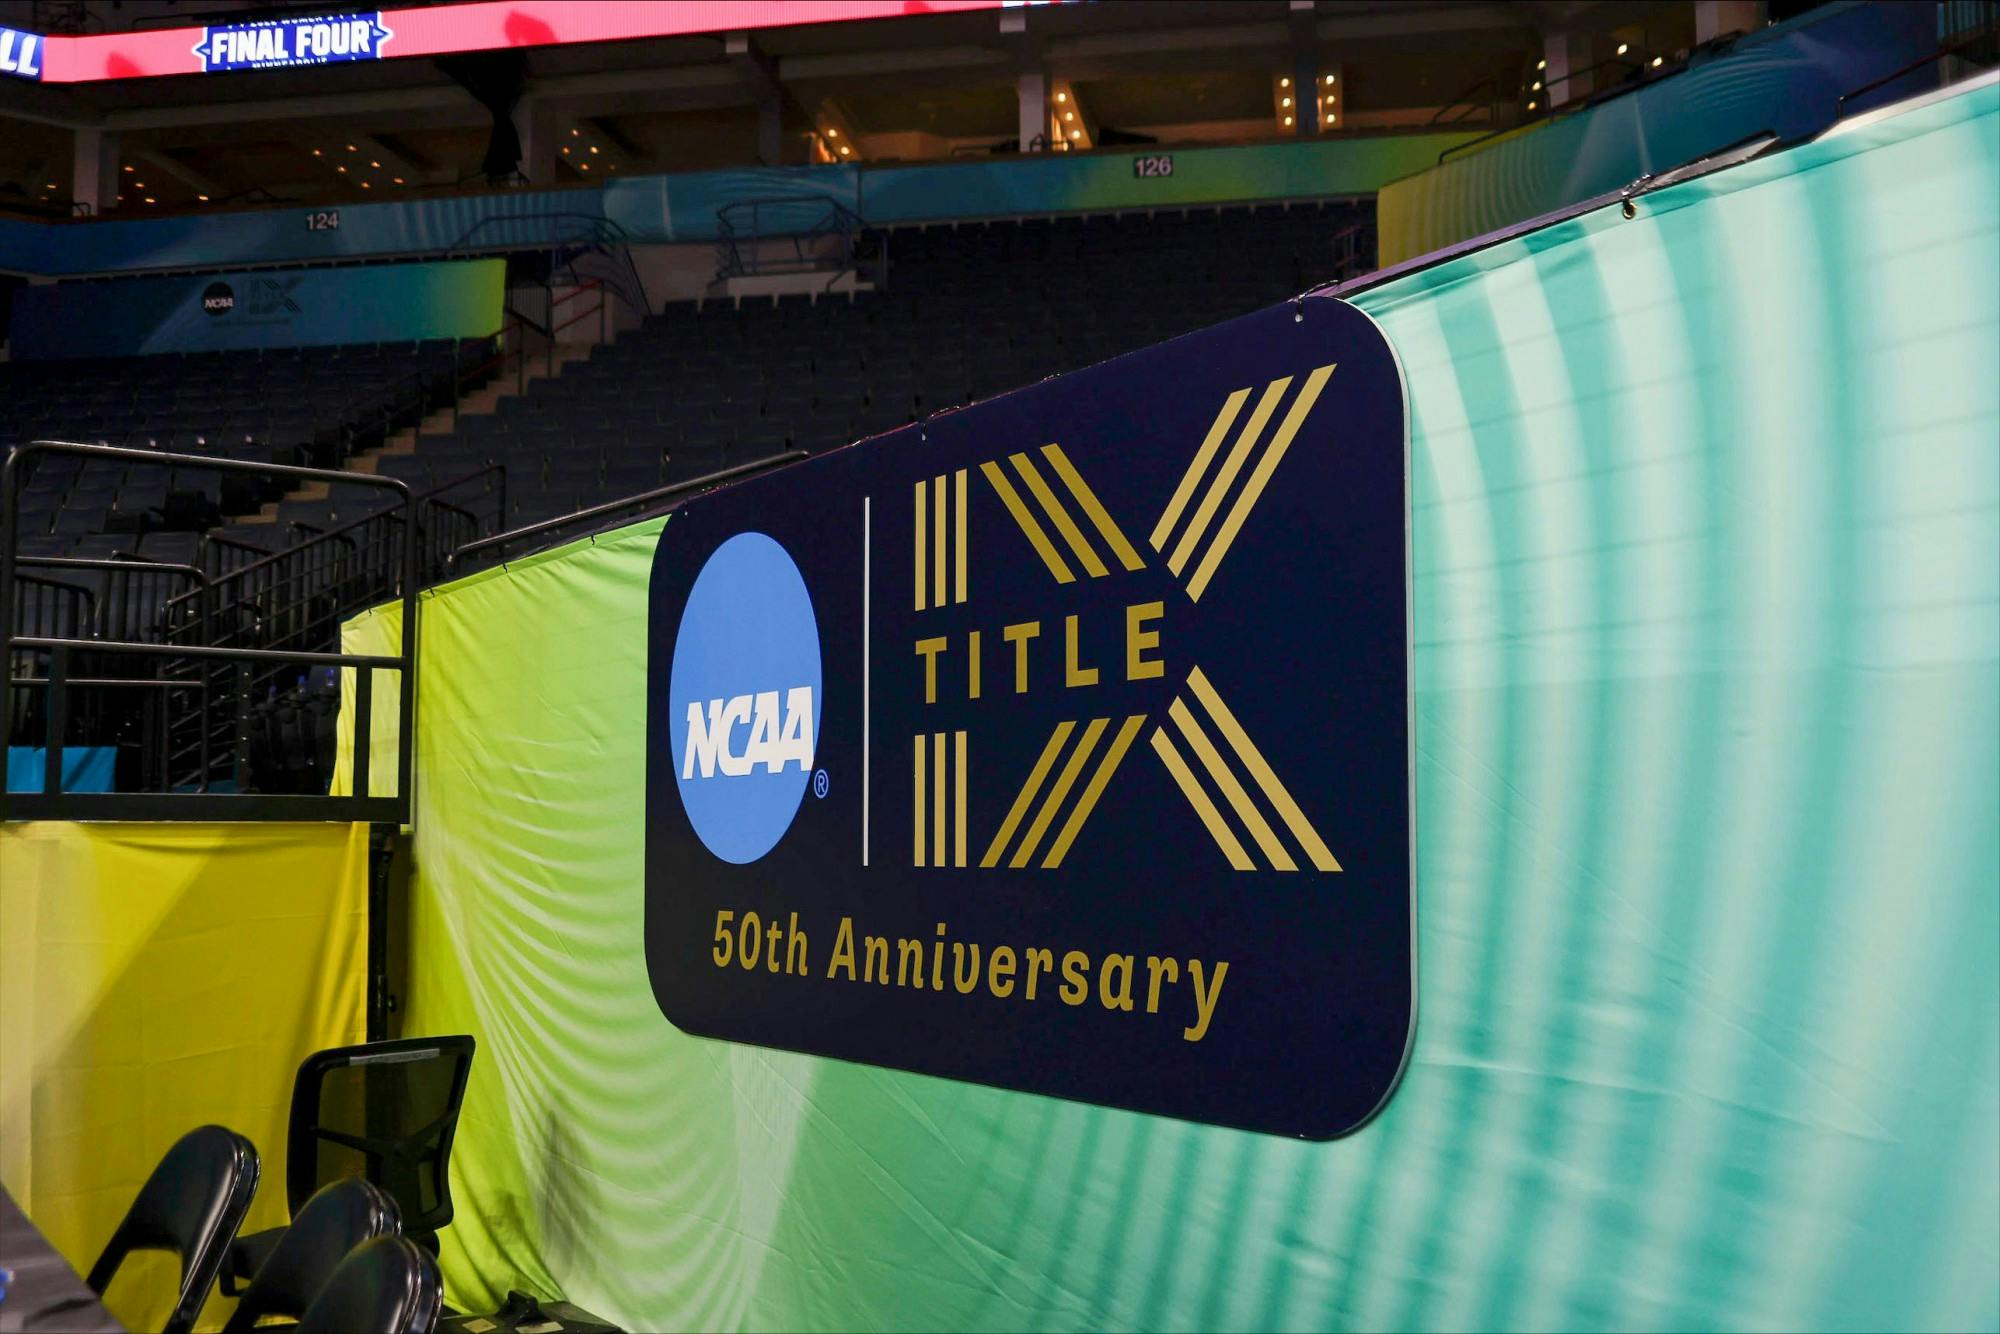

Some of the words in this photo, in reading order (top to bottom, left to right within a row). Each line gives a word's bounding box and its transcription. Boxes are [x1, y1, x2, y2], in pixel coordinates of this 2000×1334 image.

[212, 28, 289, 65] FINAL
[296, 20, 371, 58] FOUR
[1135, 156, 1172, 177] 126
[306, 212, 339, 230] 124
[204, 297, 235, 309] NCAA
[915, 601, 1165, 704] TITLE
[682, 686, 815, 780] NCAA
[712, 910, 809, 977] 50th
[826, 917, 1230, 1042] Anniversary
